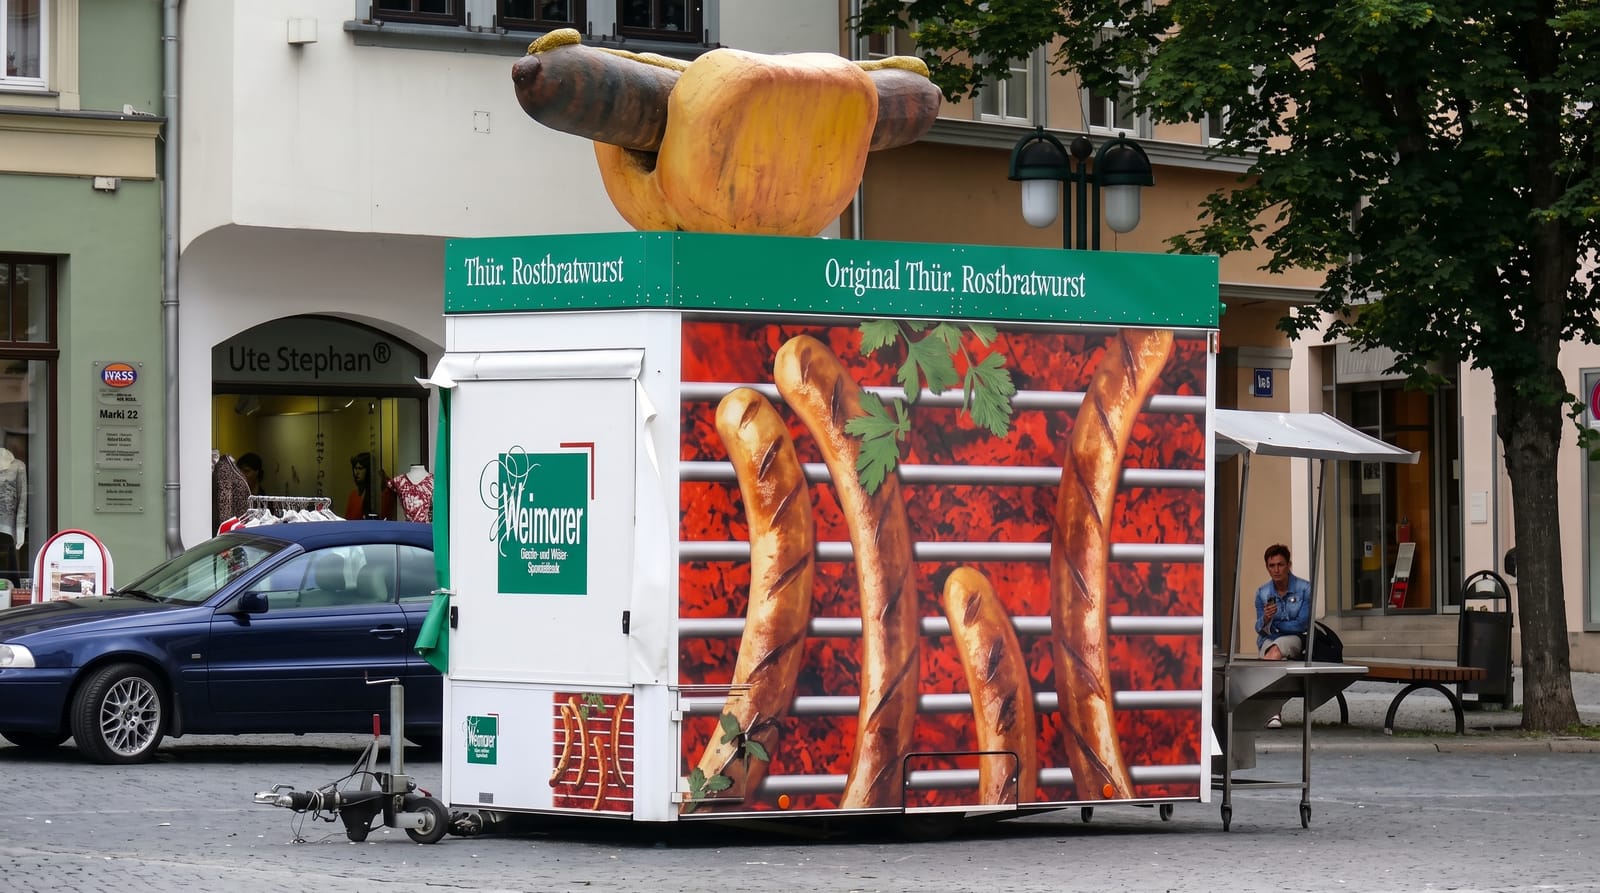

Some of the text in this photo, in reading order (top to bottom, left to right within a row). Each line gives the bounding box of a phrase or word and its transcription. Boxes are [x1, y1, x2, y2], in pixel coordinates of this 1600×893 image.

[464, 253, 624, 286] Thür. Rostbratwurst
[825, 258, 1086, 298] Original Thür. Rostbratwurst
[229, 346, 270, 372] Ute
[127, 410, 139, 419] 22
[498, 474, 583, 545] Weimarer
